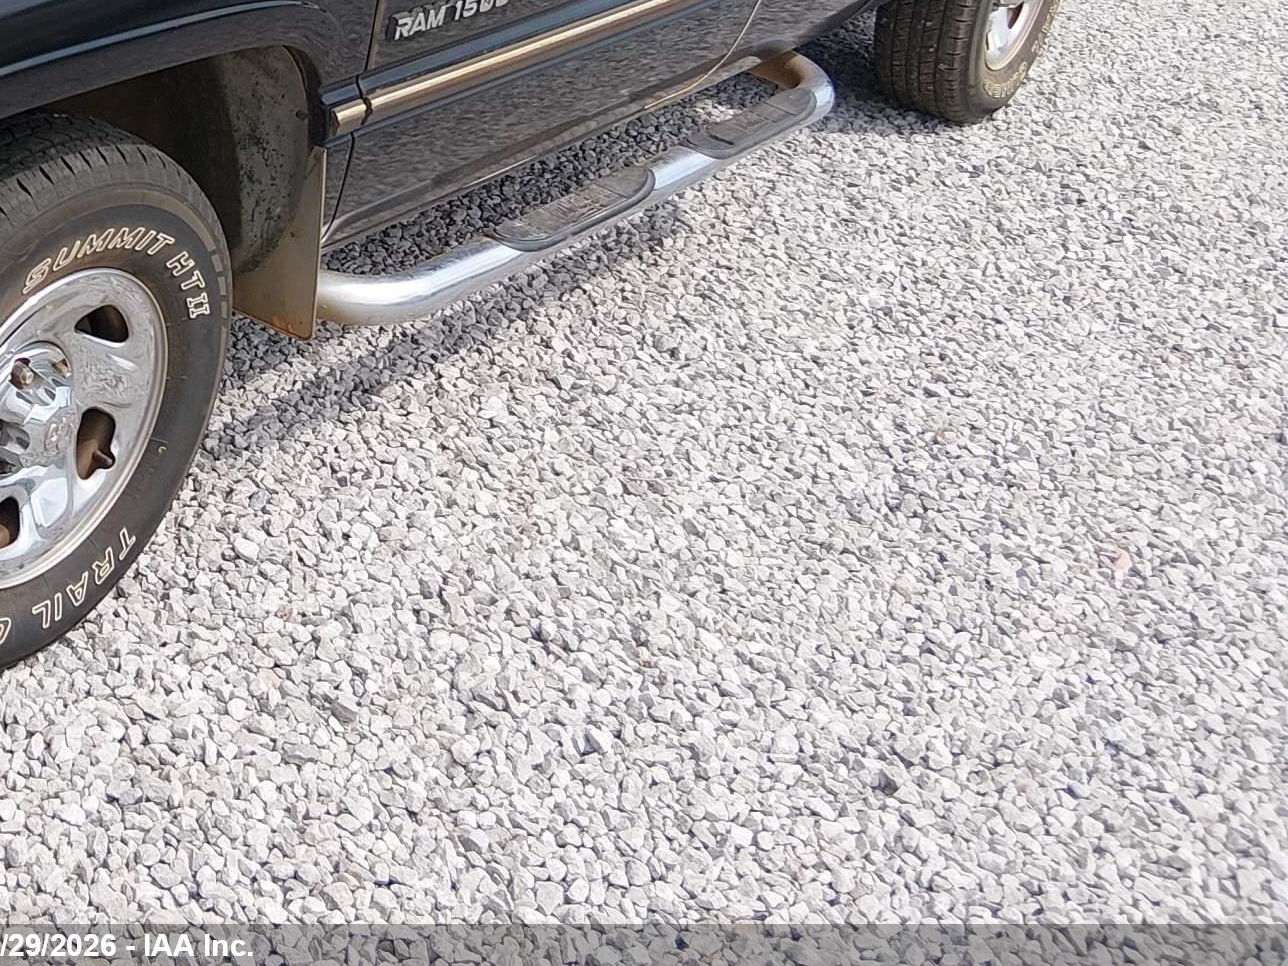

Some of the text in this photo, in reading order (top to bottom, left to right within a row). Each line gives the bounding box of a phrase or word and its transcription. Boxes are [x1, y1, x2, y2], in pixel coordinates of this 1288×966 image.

[393, 3, 451, 41] RAM
[22, 226, 176, 294] SUMMIT
[31, 527, 136, 629] TRAIL
